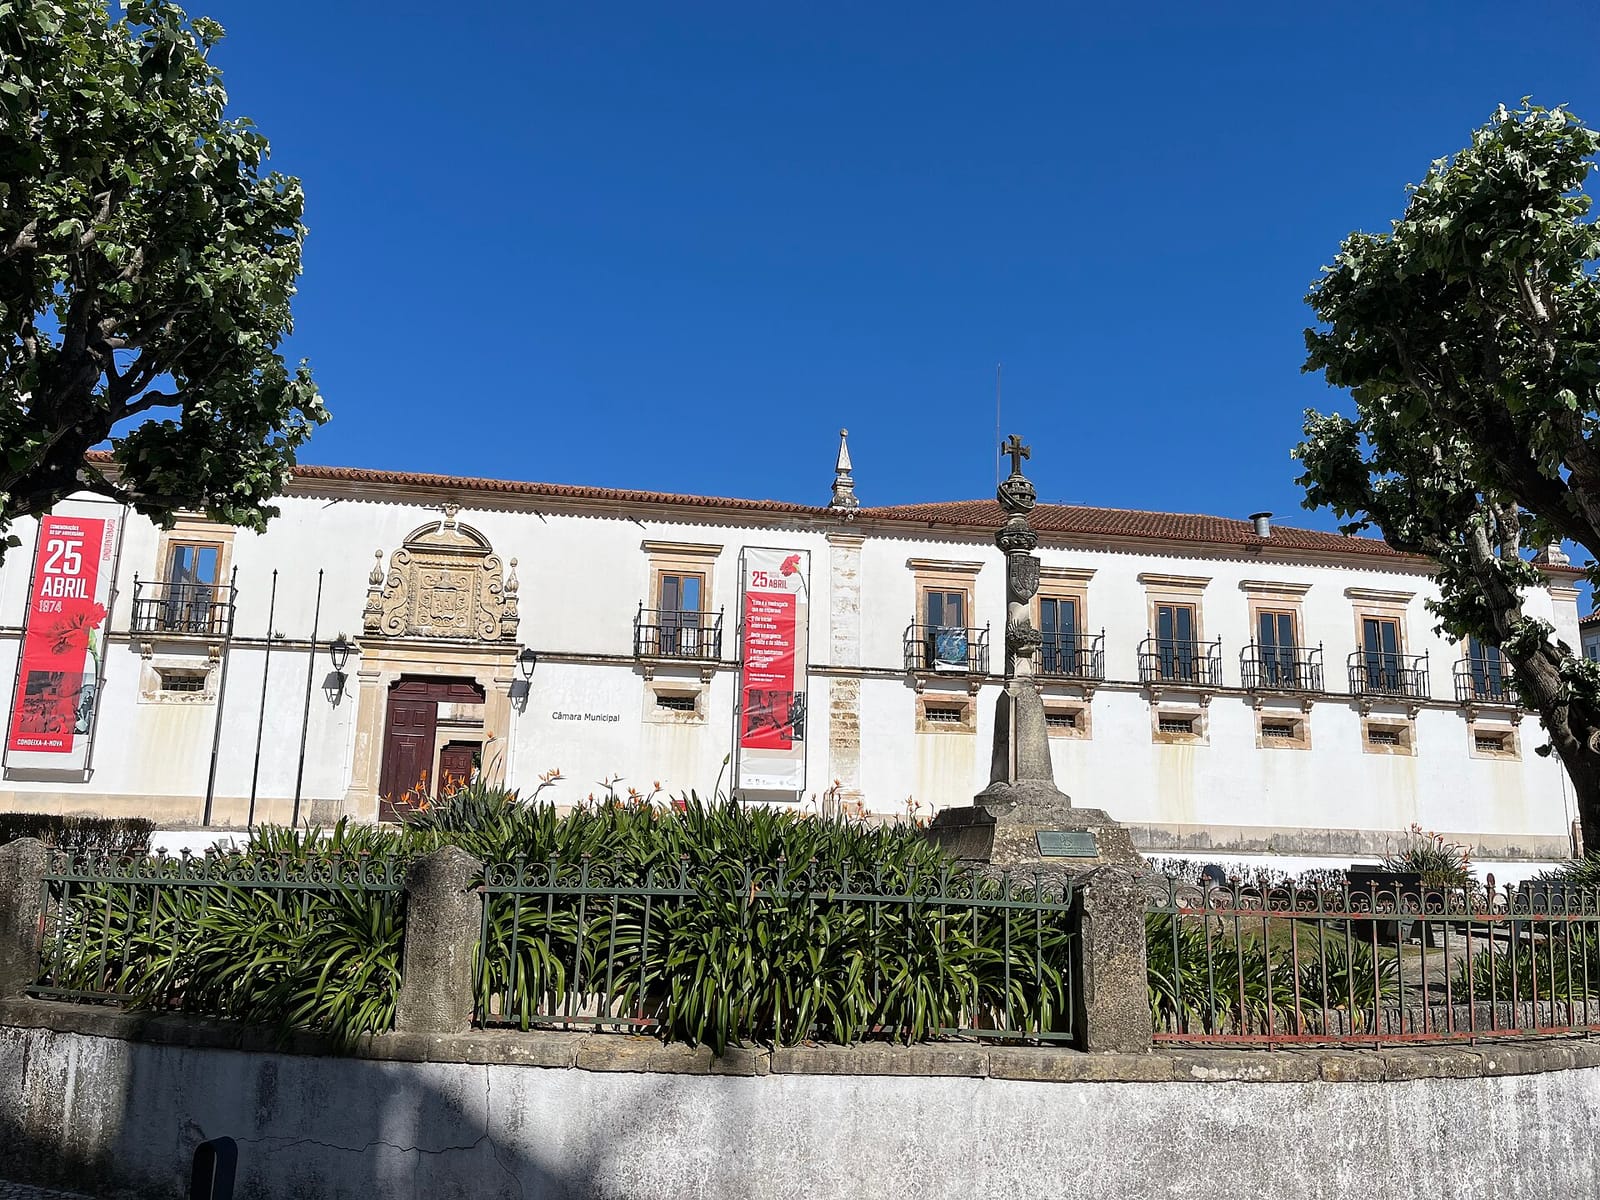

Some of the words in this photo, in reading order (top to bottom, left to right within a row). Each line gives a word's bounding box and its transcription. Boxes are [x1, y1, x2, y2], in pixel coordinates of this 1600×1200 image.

[43, 539, 83, 575] 25
[40, 576, 89, 599] ABRIL
[752, 571, 768, 587] 25
[769, 579, 788, 589] ABRIL
[552, 711, 582, 721] Câmara
[584, 713, 620, 723] Municipal
[16, 739, 63, 747] CONDEIXA-A-NOVA
